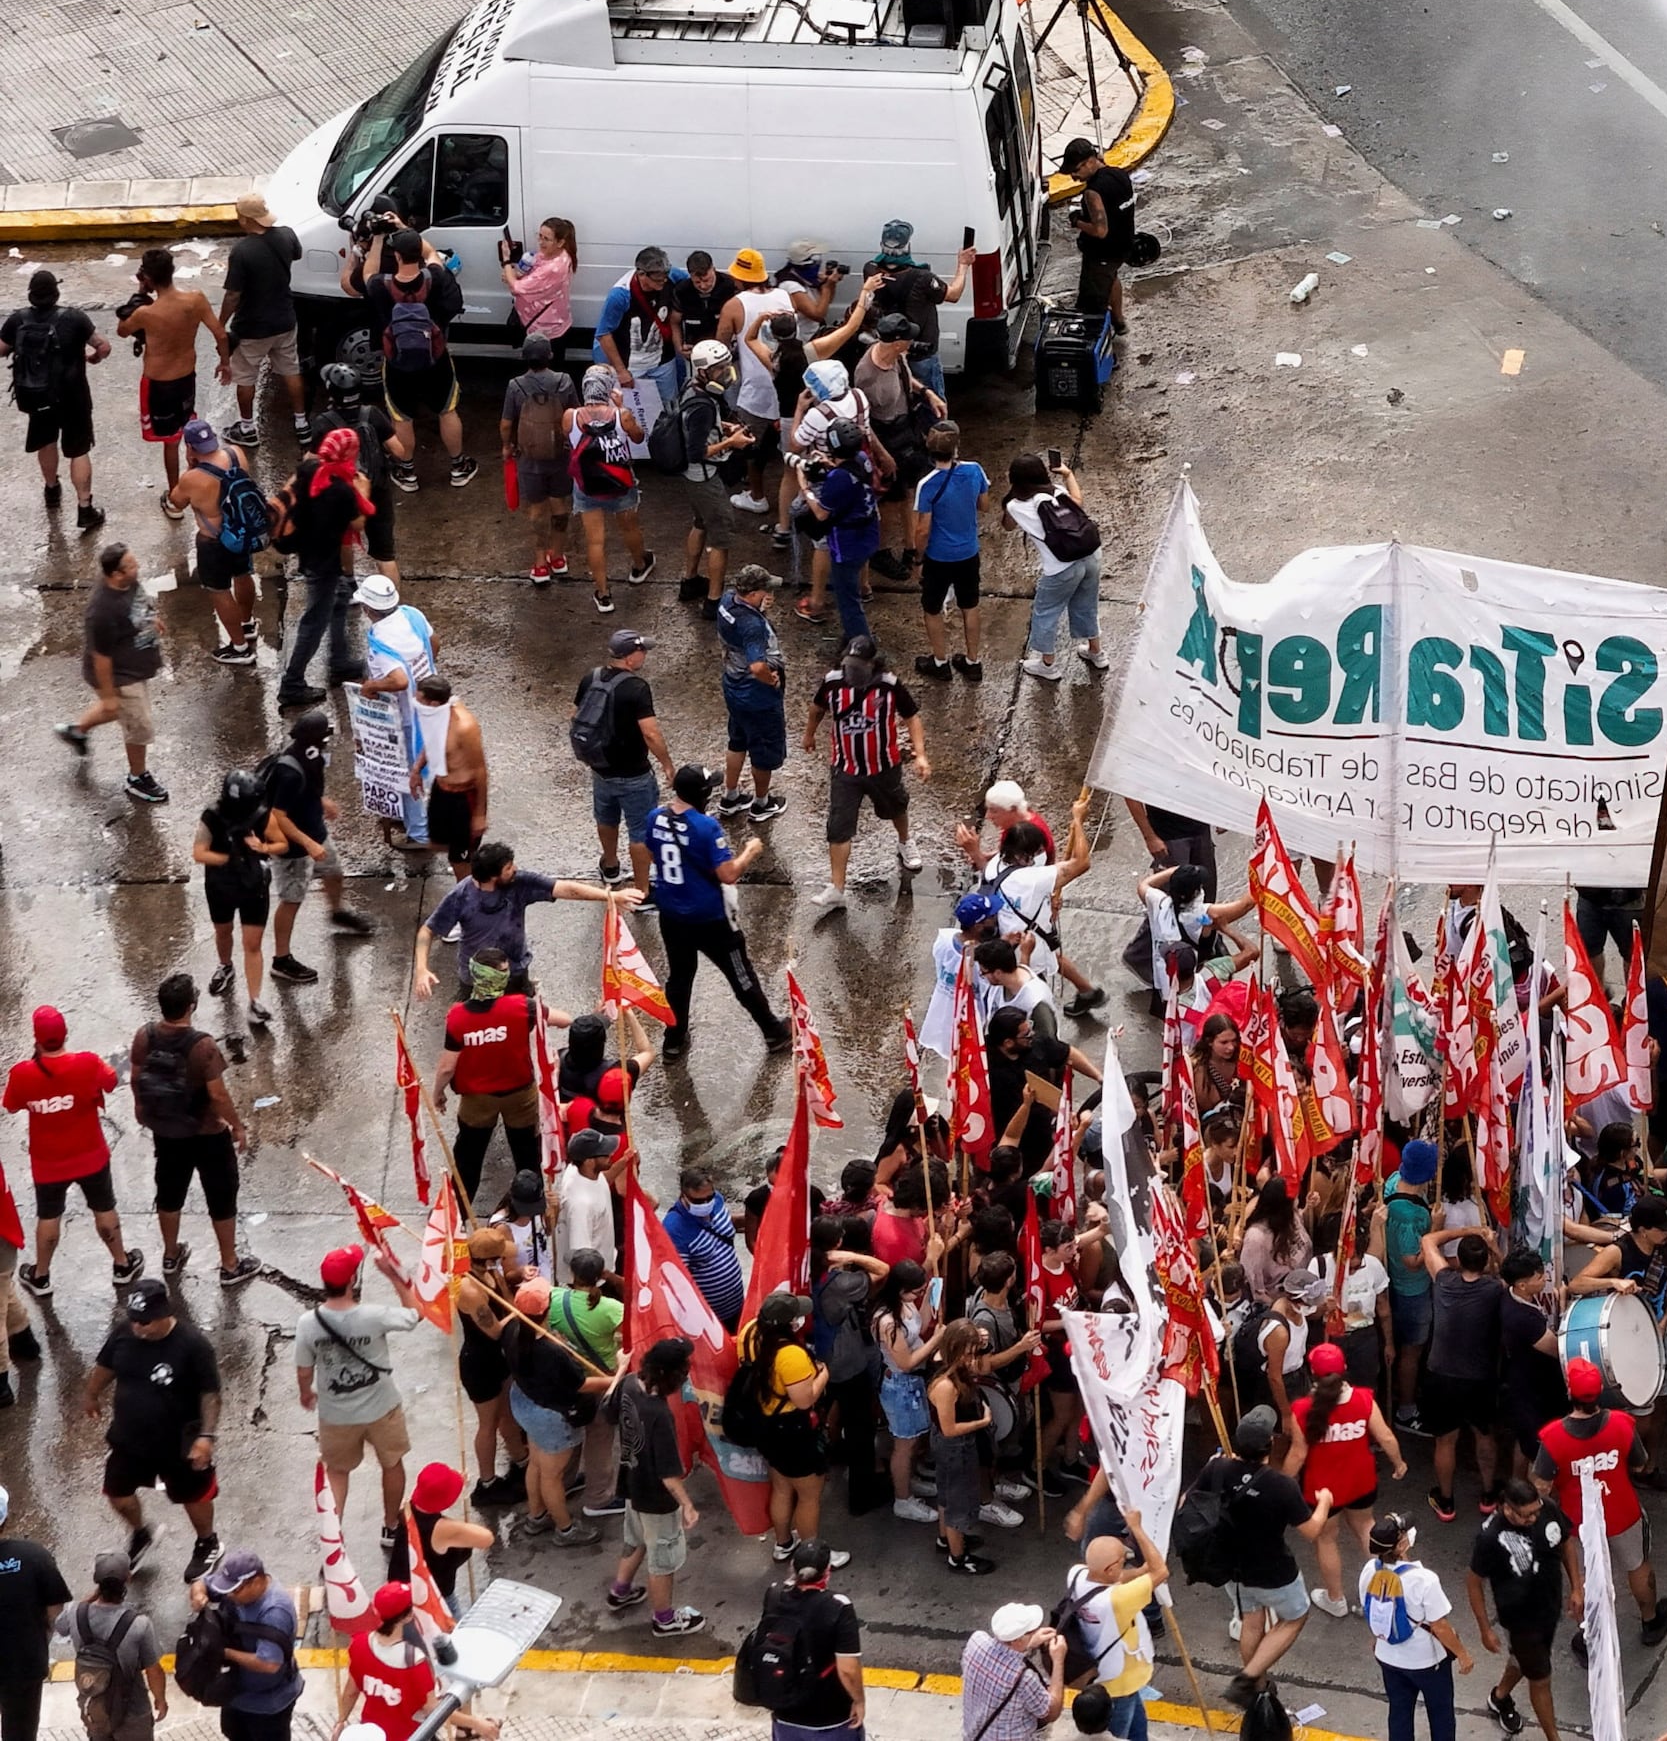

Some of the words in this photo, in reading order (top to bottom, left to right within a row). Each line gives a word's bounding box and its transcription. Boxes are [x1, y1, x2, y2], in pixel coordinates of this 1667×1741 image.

[364, 782, 400, 805] PARO
[660, 843, 684, 885] 8
[463, 1024, 509, 1047] mas
[27, 1092, 75, 1115] mas
[361, 1674, 403, 1708] mas
